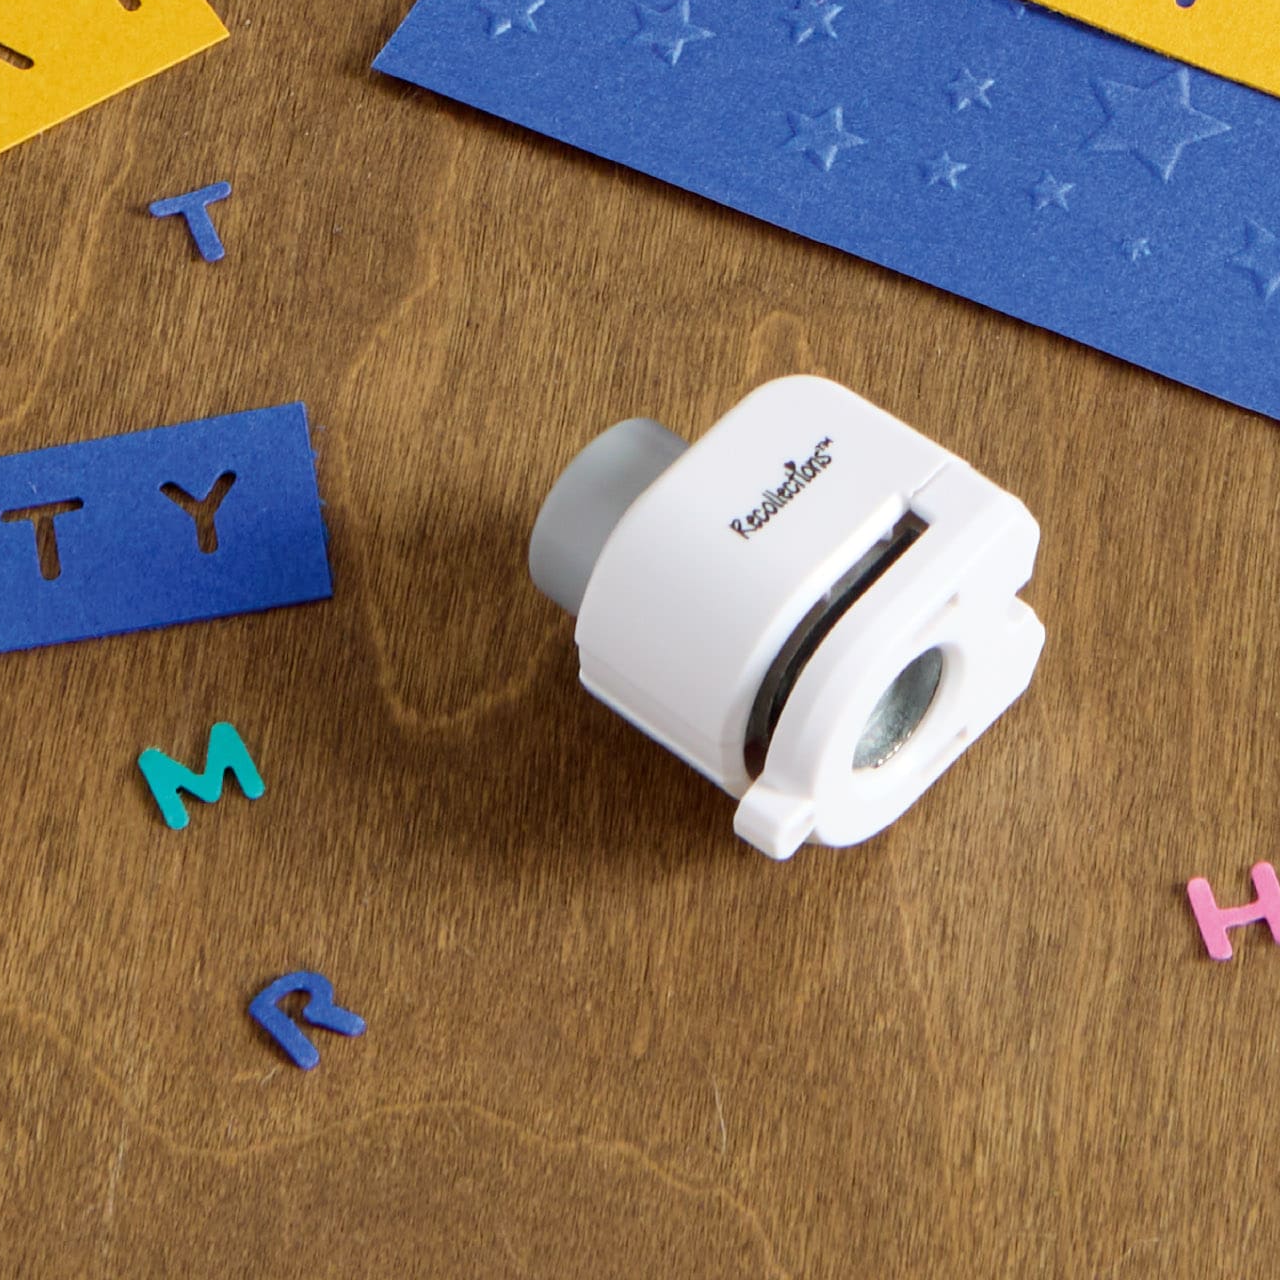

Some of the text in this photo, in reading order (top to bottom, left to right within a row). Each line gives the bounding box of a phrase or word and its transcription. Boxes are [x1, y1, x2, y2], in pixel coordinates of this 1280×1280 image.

[148, 181, 231, 261] T
[137, 721, 265, 829] M
[248, 970, 366, 1069] R
